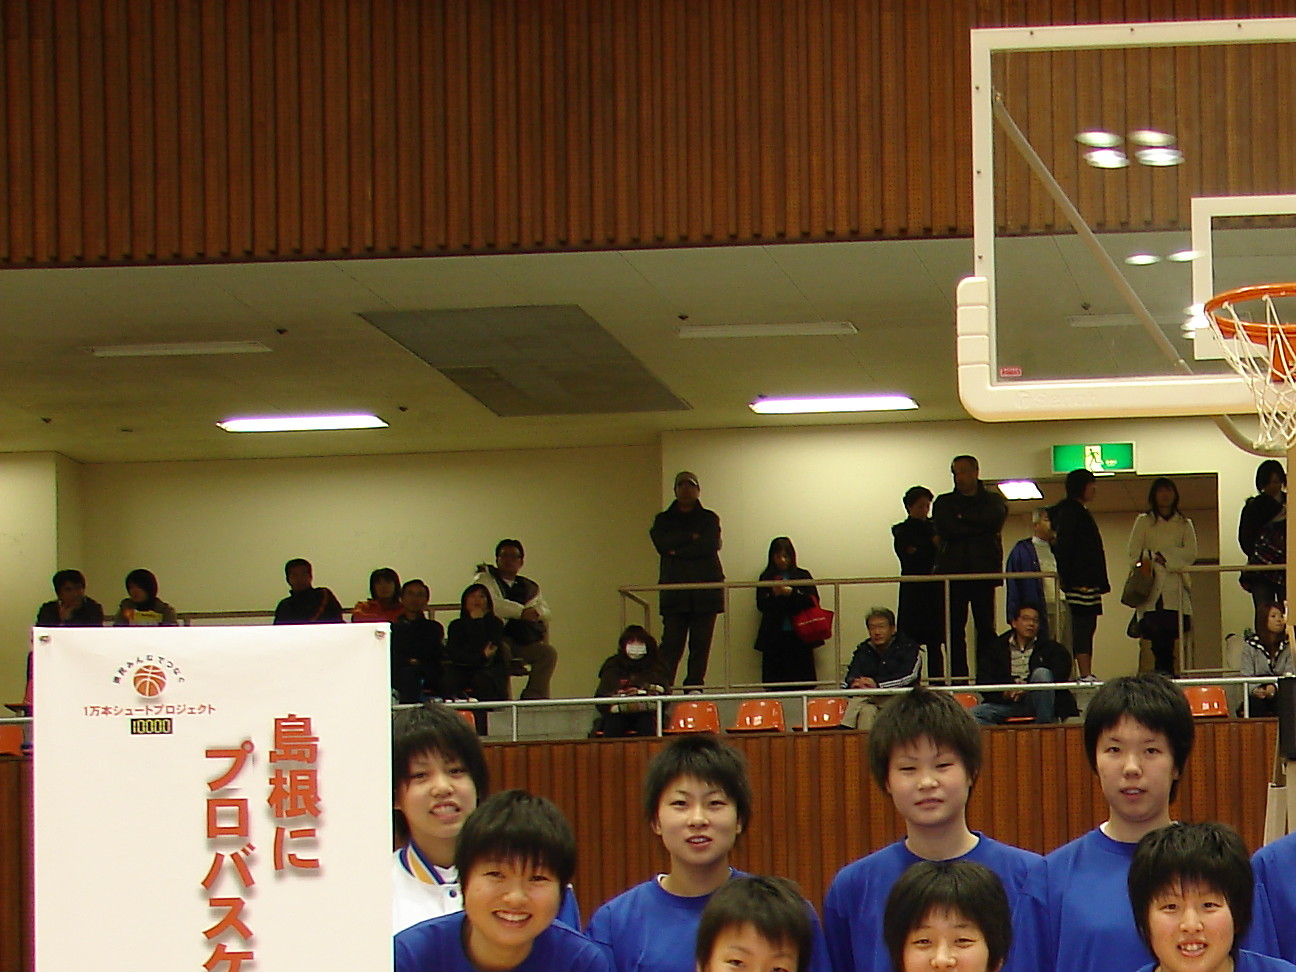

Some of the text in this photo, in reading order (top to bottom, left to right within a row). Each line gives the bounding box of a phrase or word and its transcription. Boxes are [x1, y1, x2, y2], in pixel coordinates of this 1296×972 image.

[84, 703, 216, 717] 1万本シュートプロジェクト
[266, 713, 322, 872] 島根に
